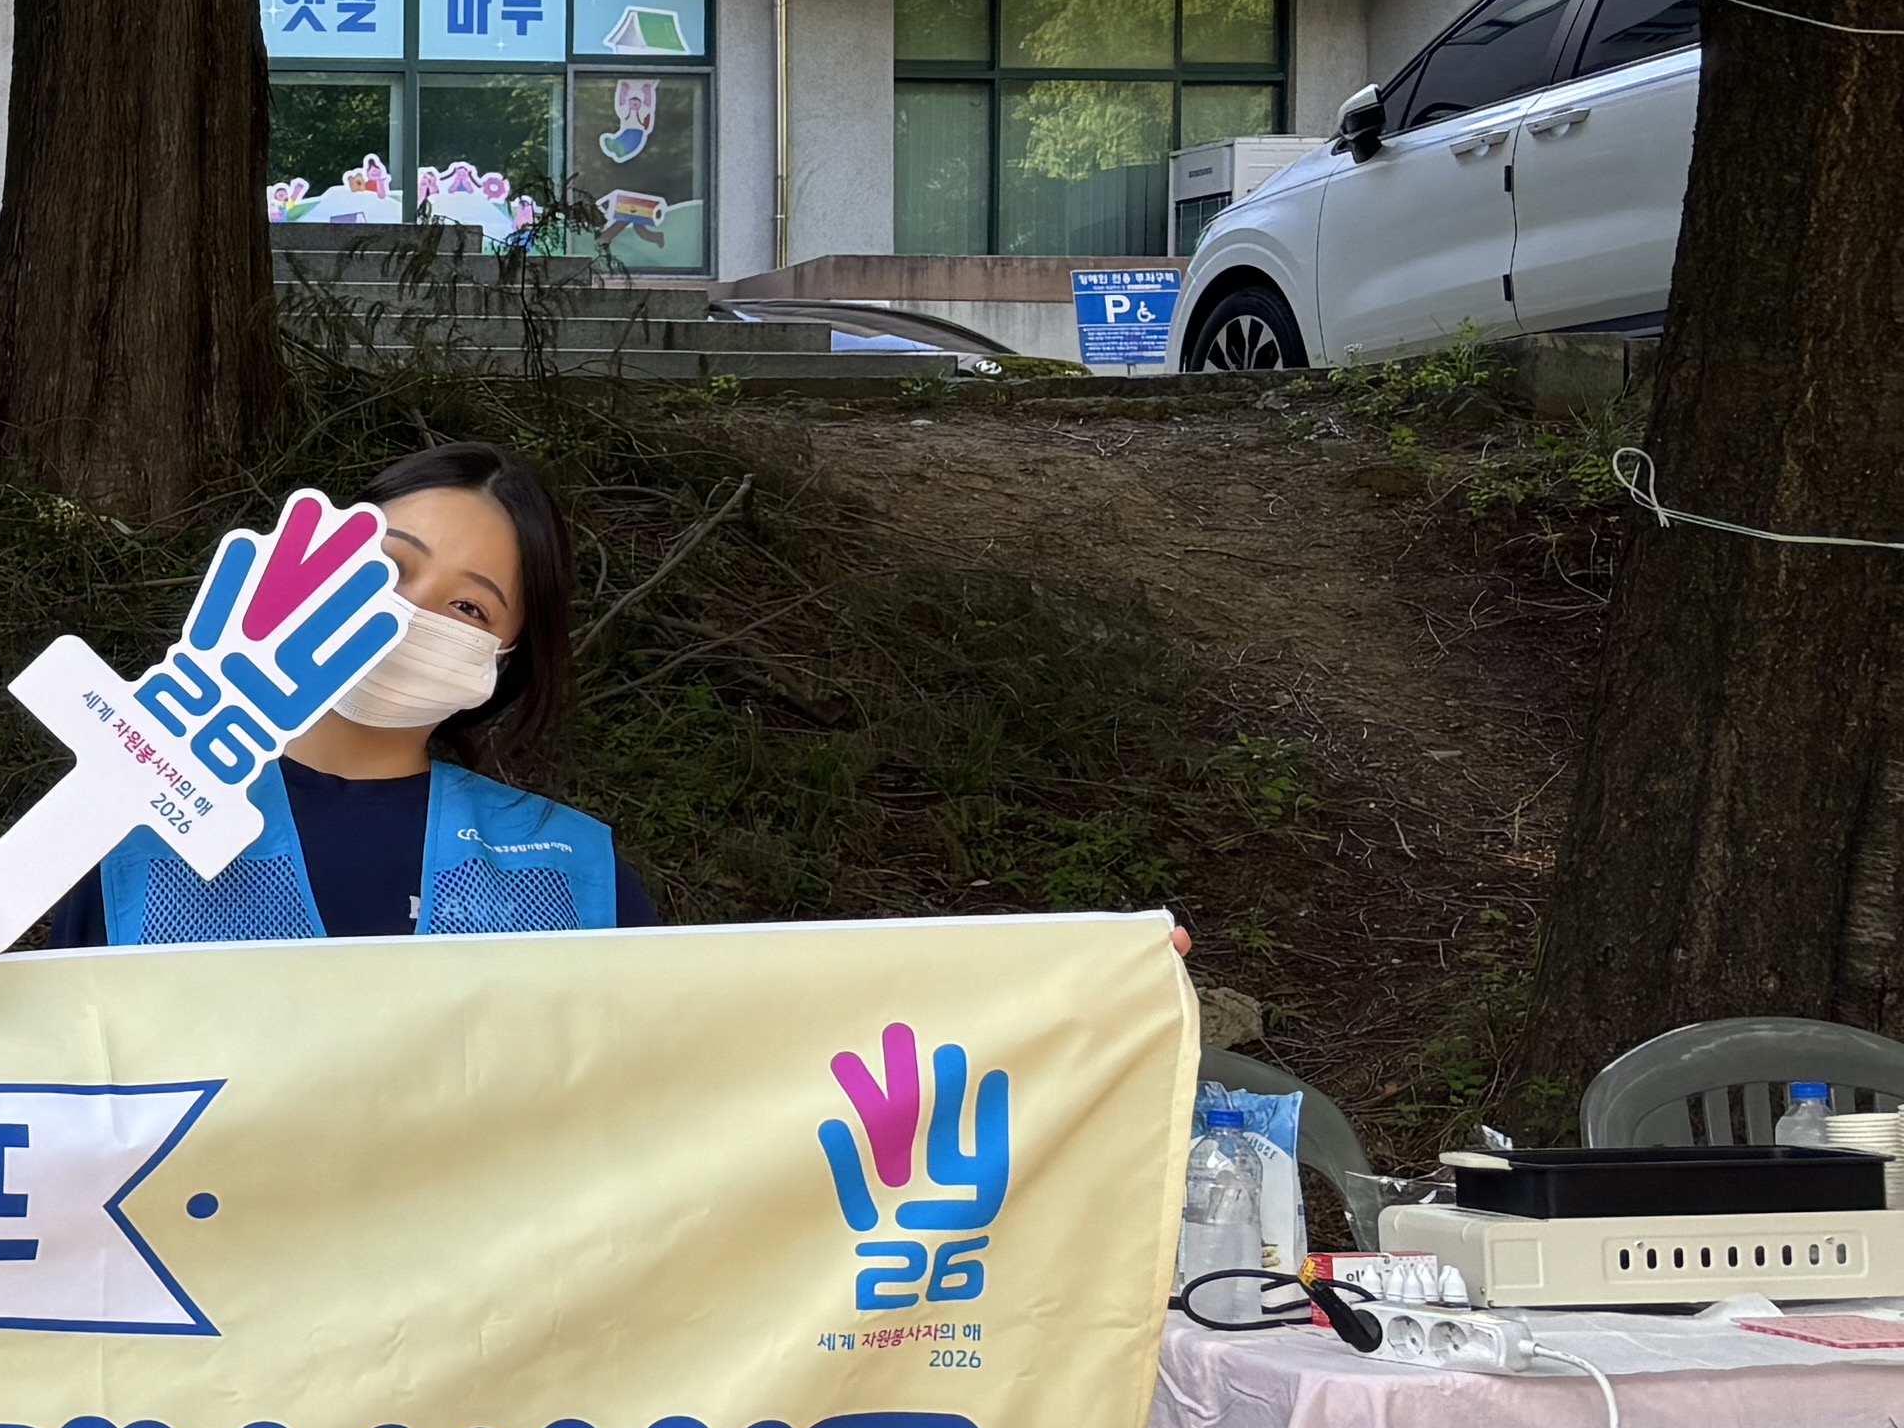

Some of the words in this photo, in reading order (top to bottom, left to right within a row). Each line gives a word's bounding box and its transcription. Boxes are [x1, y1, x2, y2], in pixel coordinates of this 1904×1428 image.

[1104, 295, 1131, 323] P
[134, 653, 277, 784] 26
[82, 690, 116, 723] 세계
[112, 718, 197, 801] 자원봉사자의
[149, 792, 193, 835] 2026
[854, 1235, 990, 1311] 26
[817, 1326, 856, 1351] 세계
[860, 1322, 956, 1349] 자원봉사자의
[928, 1350, 982, 1369] 2026
